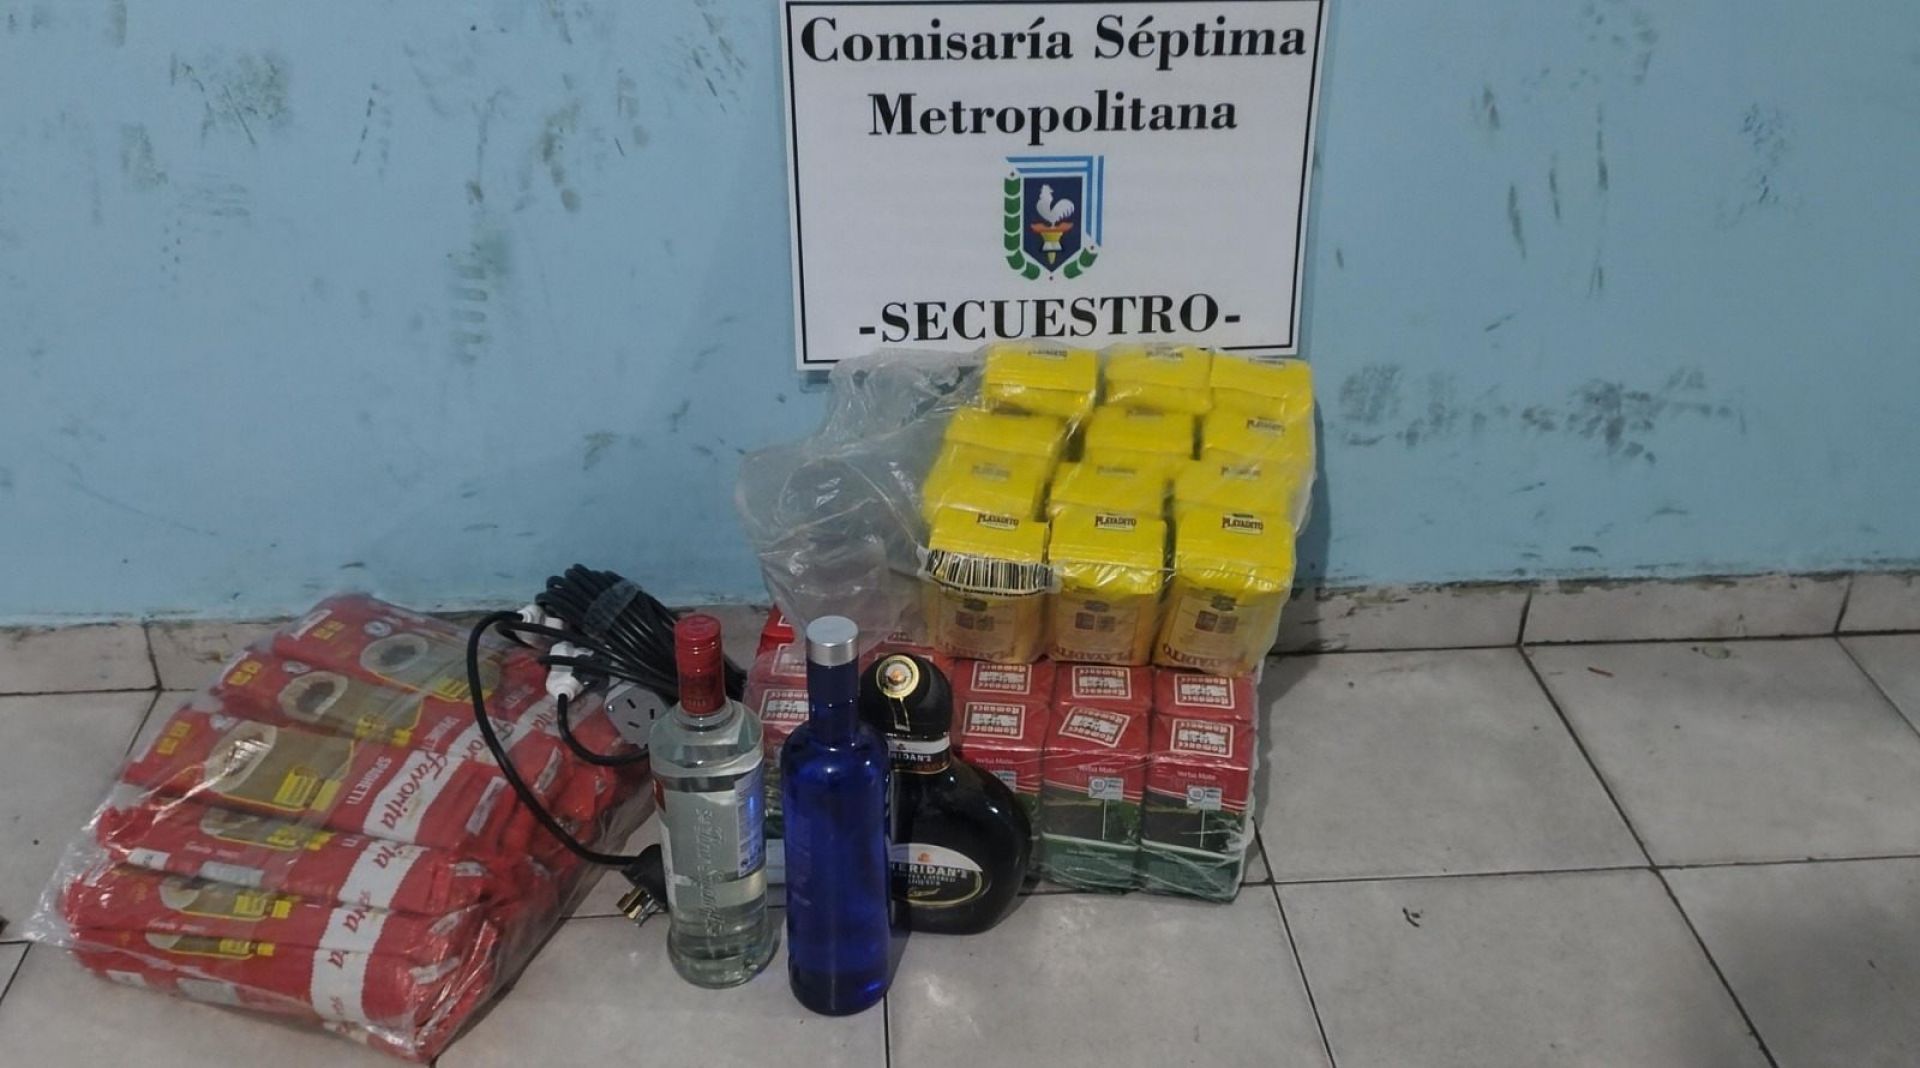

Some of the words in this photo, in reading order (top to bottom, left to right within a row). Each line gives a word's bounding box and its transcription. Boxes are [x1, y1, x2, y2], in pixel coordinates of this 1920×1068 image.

[800, 17, 1073, 62] Comisaría
[1094, 14, 1307, 71] Séptima
[867, 90, 1237, 146] Metropolitana
[858, 293, 1242, 343] -SECUESTRO-
[977, 513, 1019, 526] PLAYADITO
[1095, 515, 1136, 527] PLAYADITO
[1222, 517, 1263, 530] PLAYADITO
[381, 750, 448, 830] Favorita
